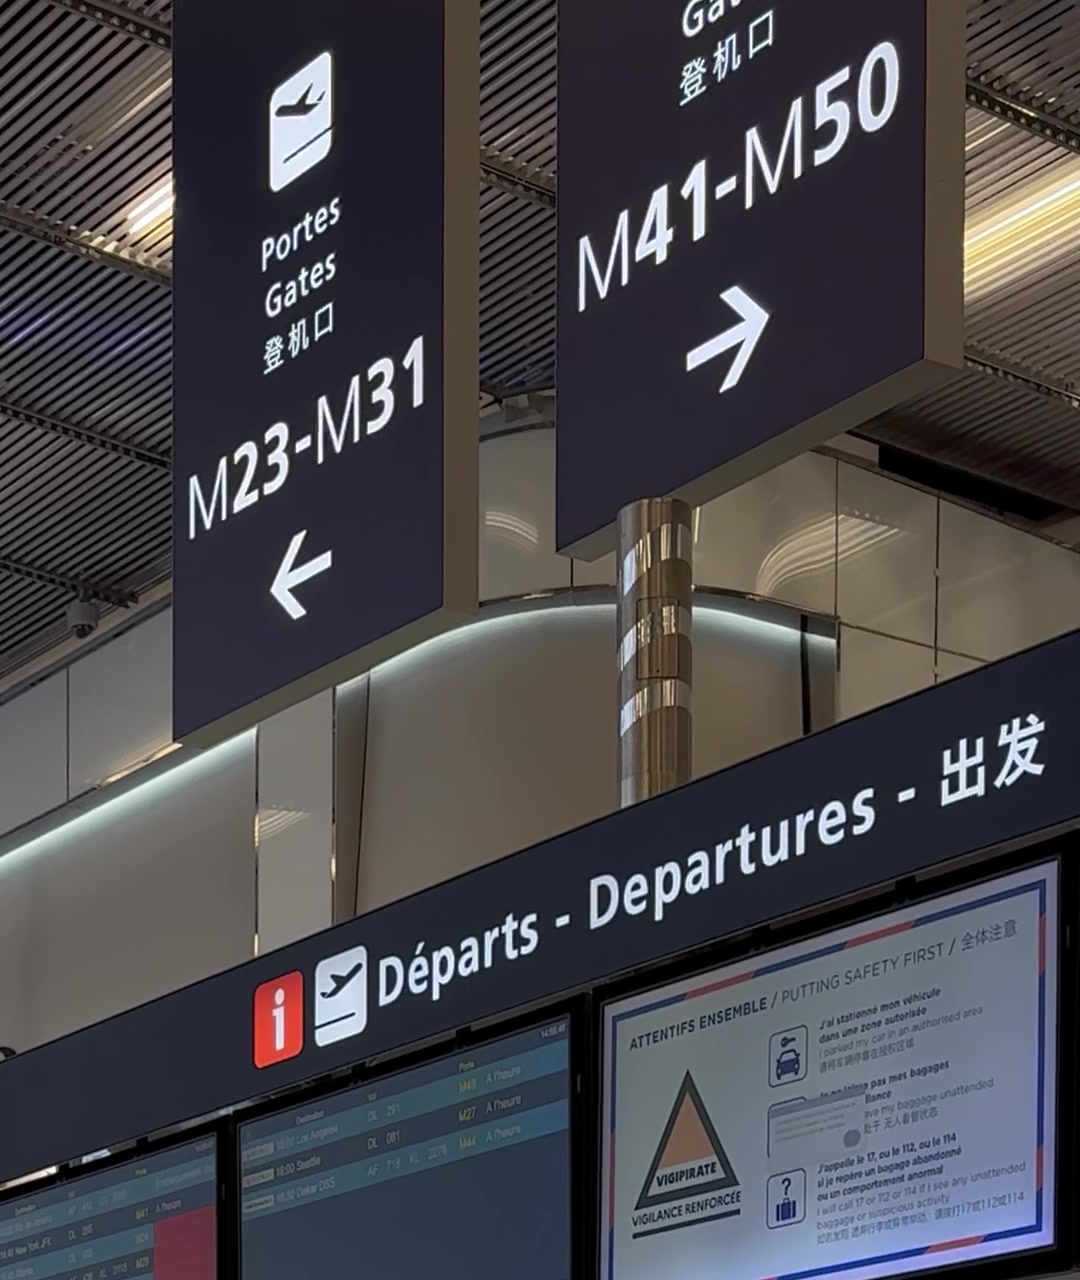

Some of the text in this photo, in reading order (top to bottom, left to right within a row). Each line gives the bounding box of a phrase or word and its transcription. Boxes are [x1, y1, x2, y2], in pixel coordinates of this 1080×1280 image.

[680, 10, 773, 106] 登机口
[578, 41, 900, 313] M41-M50
[262, 196, 341, 272] Portes
[265, 253, 337, 318] Gates
[263, 301, 334, 376] 登机口
[187, 336, 426, 539] M23-M31
[378, 712, 1046, 1007] Départs Departures 出发
[628, 1017, 695, 1051] ATTENTIFS
[698, 995, 767, 1030] ENSEMBLE
[781, 973, 840, 1005] PUTTING
[843, 954, 899, 987] SAFETY
[903, 941, 945, 968] FIRST
[836, 1003, 878, 1026] stationné
[879, 999, 900, 1013] mon
[902, 985, 941, 1007] véhicule
[818, 1004, 927, 1045] dans une zone autorisée
[870, 1076, 887, 1090] pas
[888, 1070, 908, 1084] mes
[909, 1057, 950, 1080] bagages
[656, 1160, 717, 1188] VIGIPIRATE
[856, 1152, 865, 1165] le
[878, 1149, 890, 1160] ou
[891, 1144, 900, 1156] le
[918, 1139, 931, 1150] ou
[932, 1134, 941, 1147] le
[877, 1157, 910, 1176] bagage
[911, 1144, 962, 1167] abandonné
[631, 1188, 742, 1228] VIGILANCE RENFORCÉE
[816, 1163, 943, 1202] ou un comportement anormal
